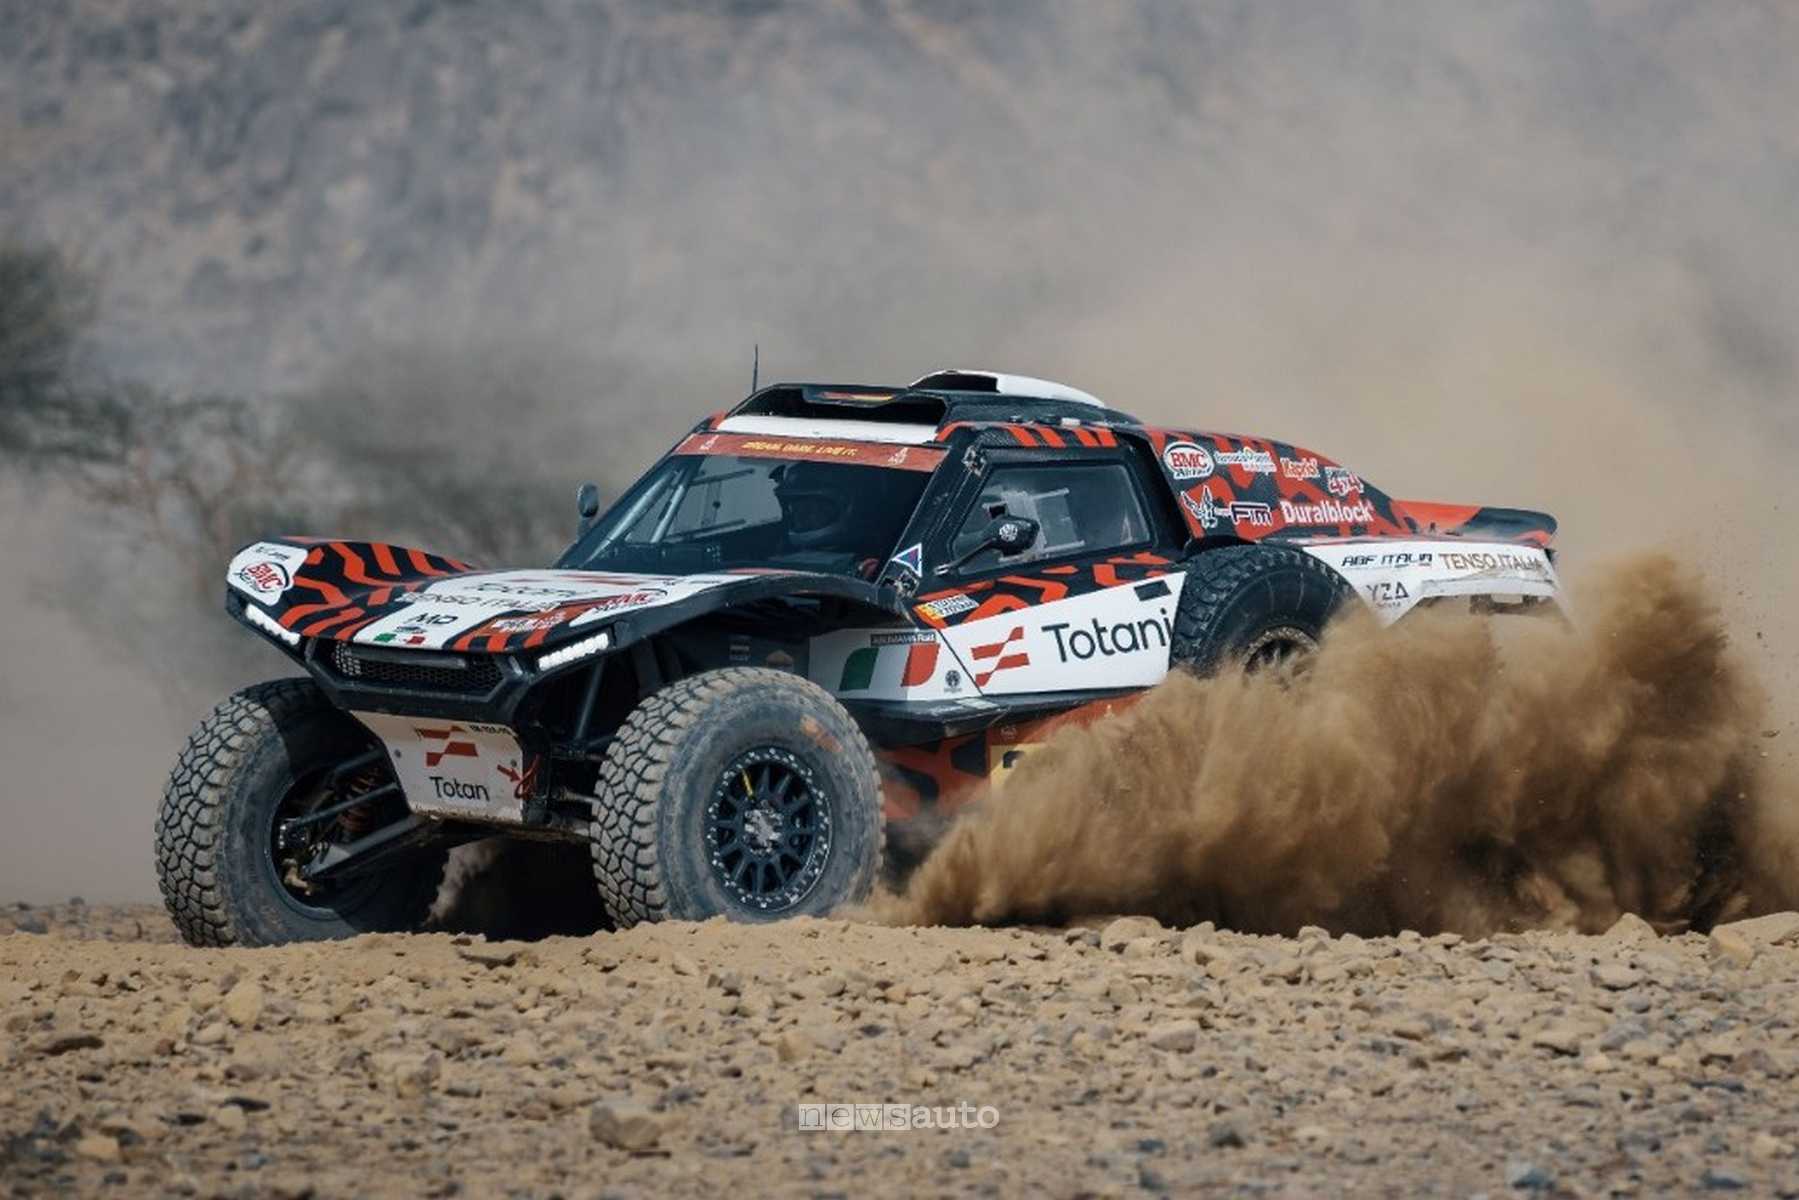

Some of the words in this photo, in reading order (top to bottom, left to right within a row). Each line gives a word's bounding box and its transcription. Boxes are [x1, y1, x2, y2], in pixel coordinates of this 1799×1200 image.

[1171, 452, 1208, 469] BMC
[1280, 500, 1374, 523] Duralblock
[1438, 553, 1497, 569] TENSO
[1498, 554, 1542, 570] ITALIA
[1041, 608, 1172, 662] Totani
